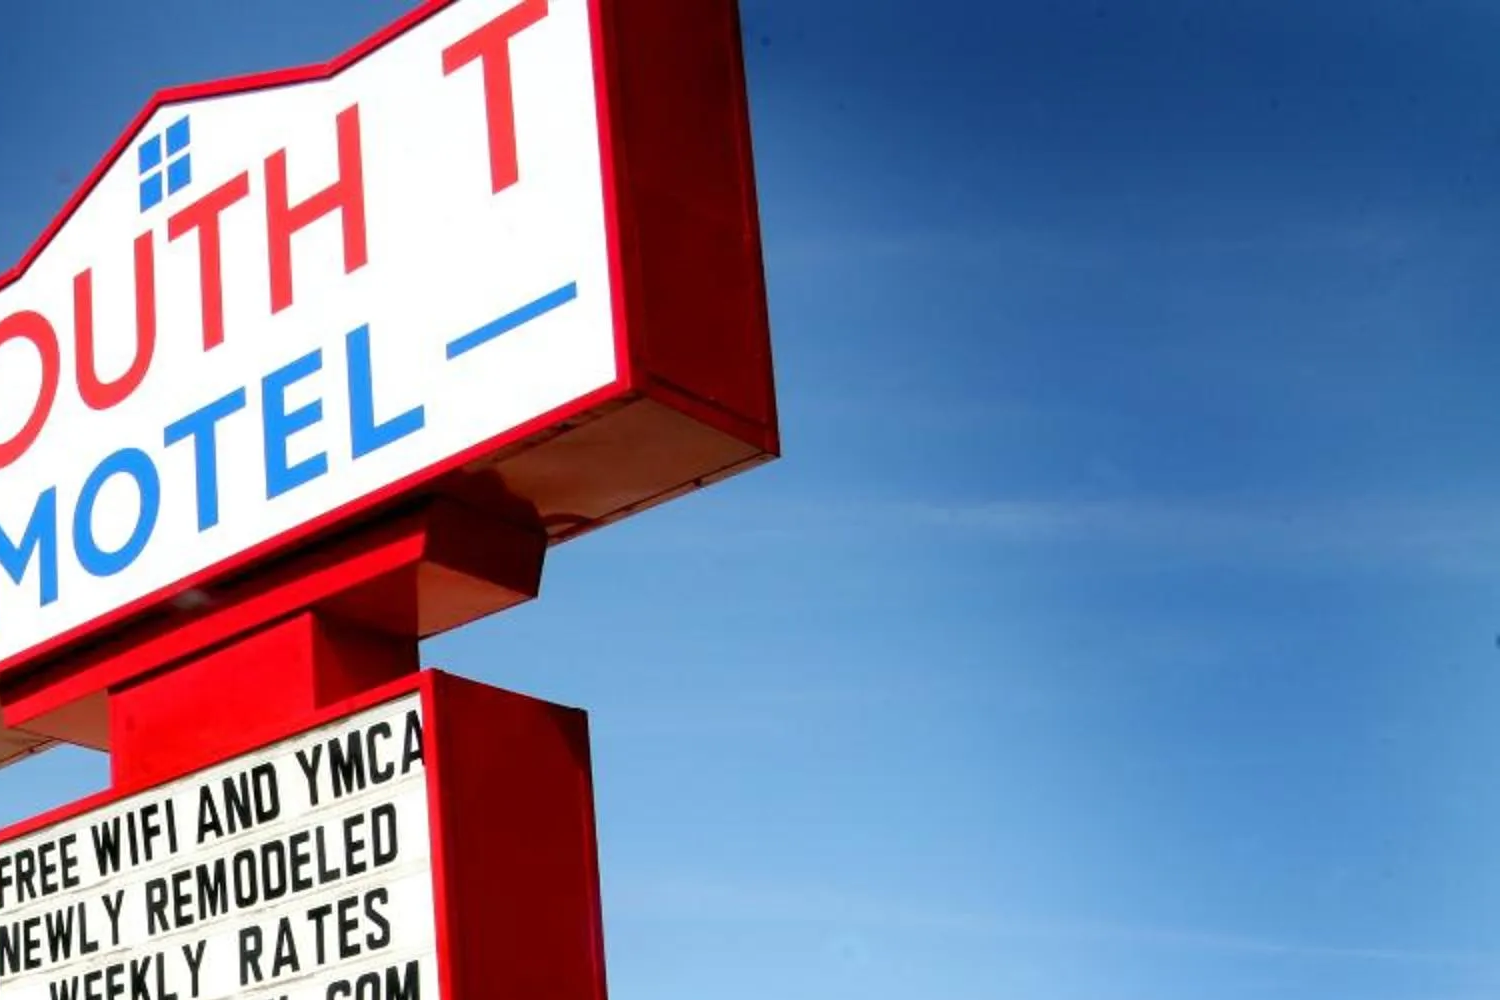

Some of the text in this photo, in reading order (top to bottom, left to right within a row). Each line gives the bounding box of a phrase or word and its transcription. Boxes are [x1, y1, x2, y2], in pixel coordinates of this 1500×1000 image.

[442, 0, 549, 194] T
[90, 798, 179, 877] WIFI
[196, 762, 281, 844] AND
[295, 709, 426, 807] YMCA
[145, 803, 398, 936] REMODELED
[239, 887, 392, 987] RATES
